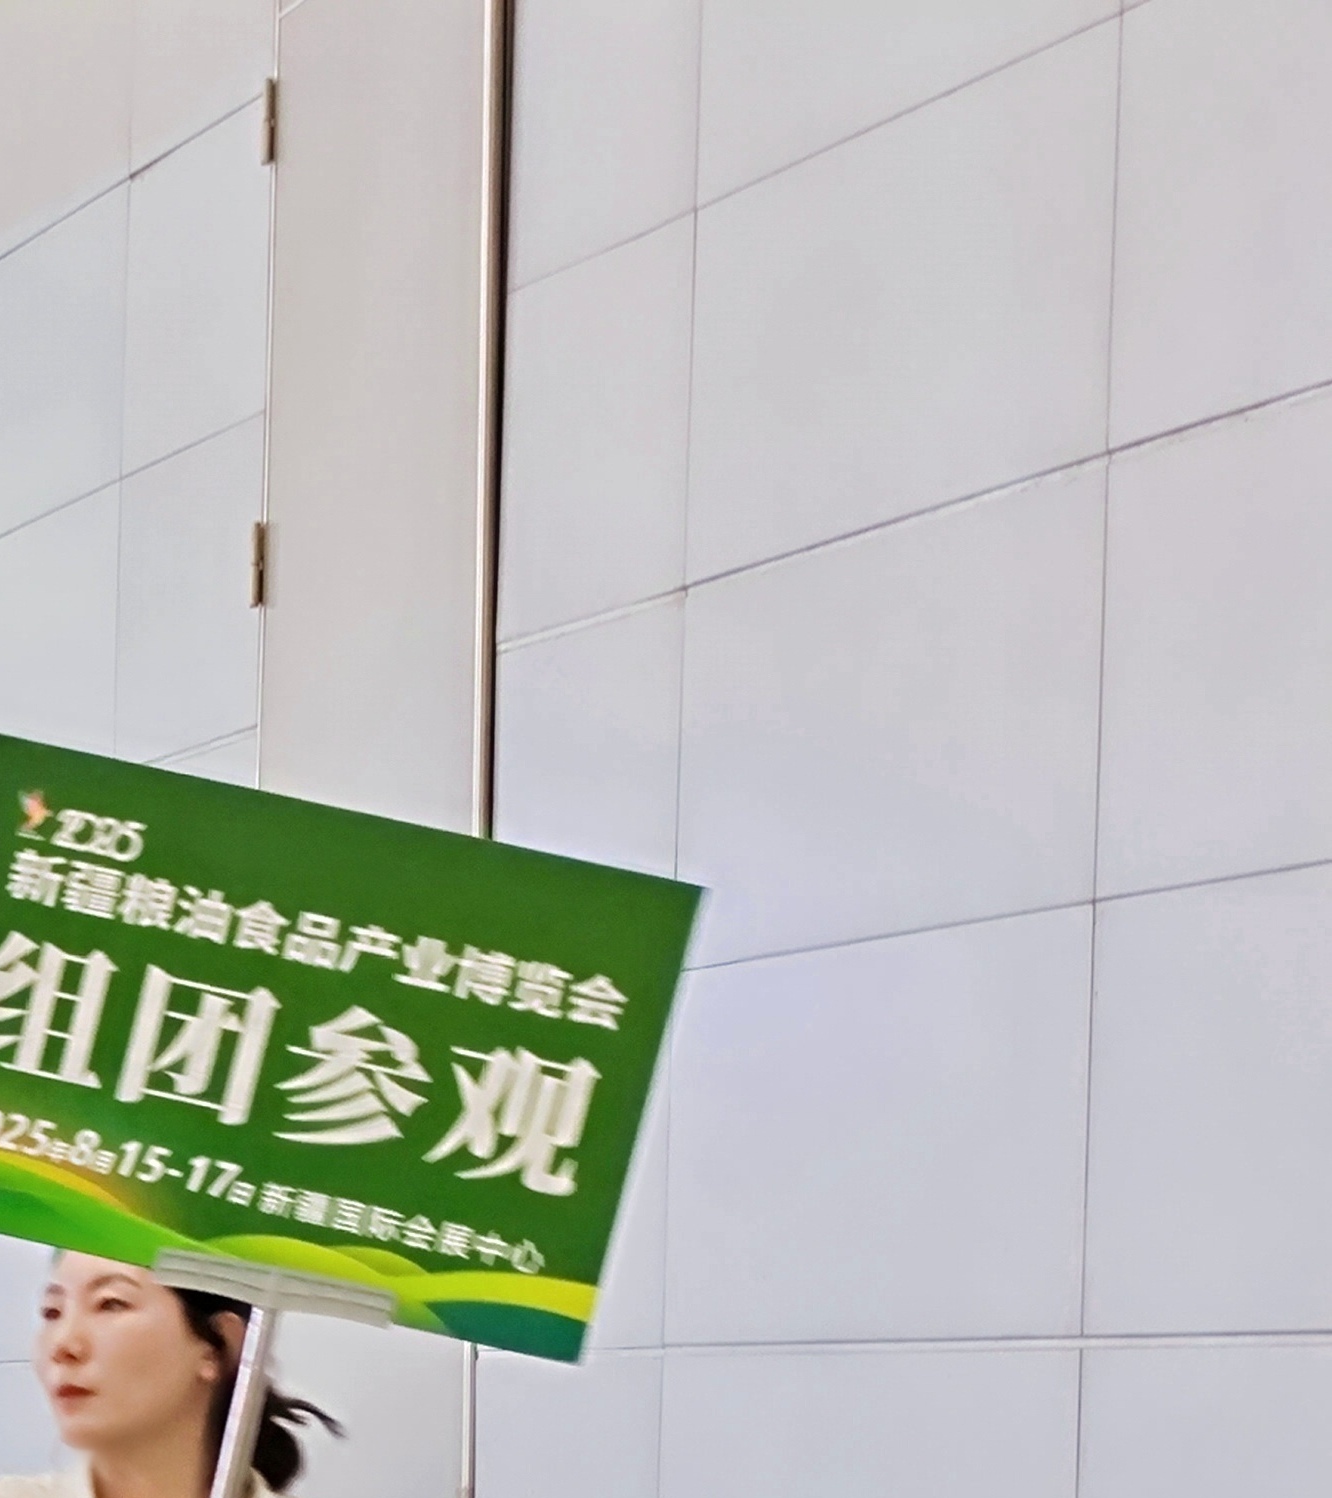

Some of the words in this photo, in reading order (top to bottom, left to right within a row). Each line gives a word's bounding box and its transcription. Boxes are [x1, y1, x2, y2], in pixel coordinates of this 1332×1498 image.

[6, 850, 630, 1032] 新疆粮油食品产业博览会
[257, 1181, 546, 1275] 新疆国际会展中心
